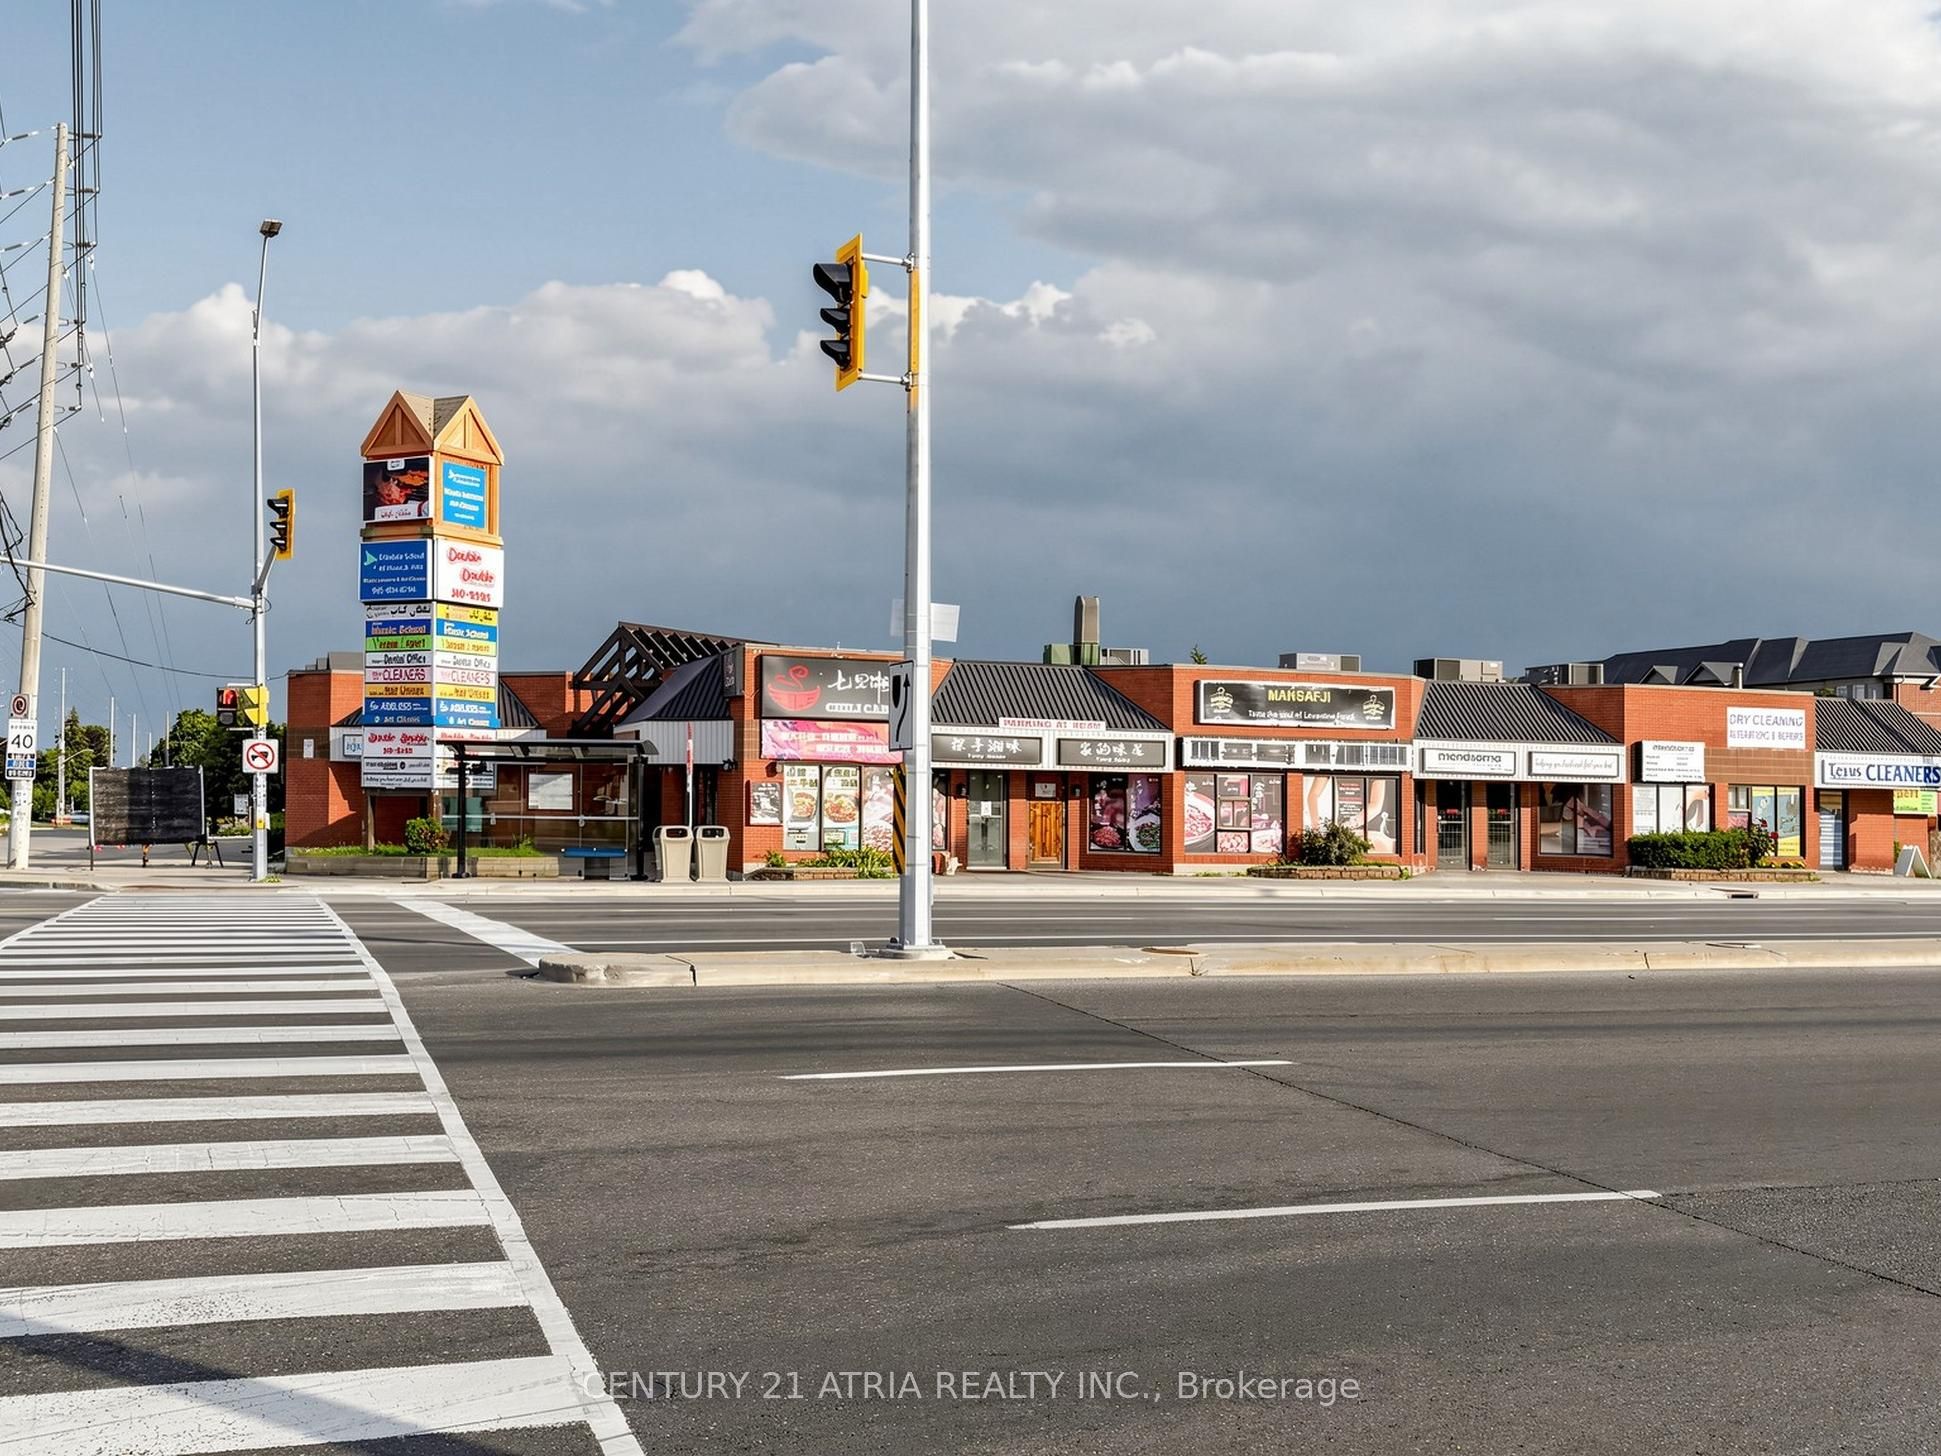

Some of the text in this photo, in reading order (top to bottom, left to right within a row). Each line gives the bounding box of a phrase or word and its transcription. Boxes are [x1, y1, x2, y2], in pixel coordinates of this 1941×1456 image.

[382, 669, 426, 681] CLEANERS
[1729, 713, 1804, 727] DRY CLEANING
[11, 734, 33, 749] 40
[1866, 763, 1941, 784] CLEANERS
